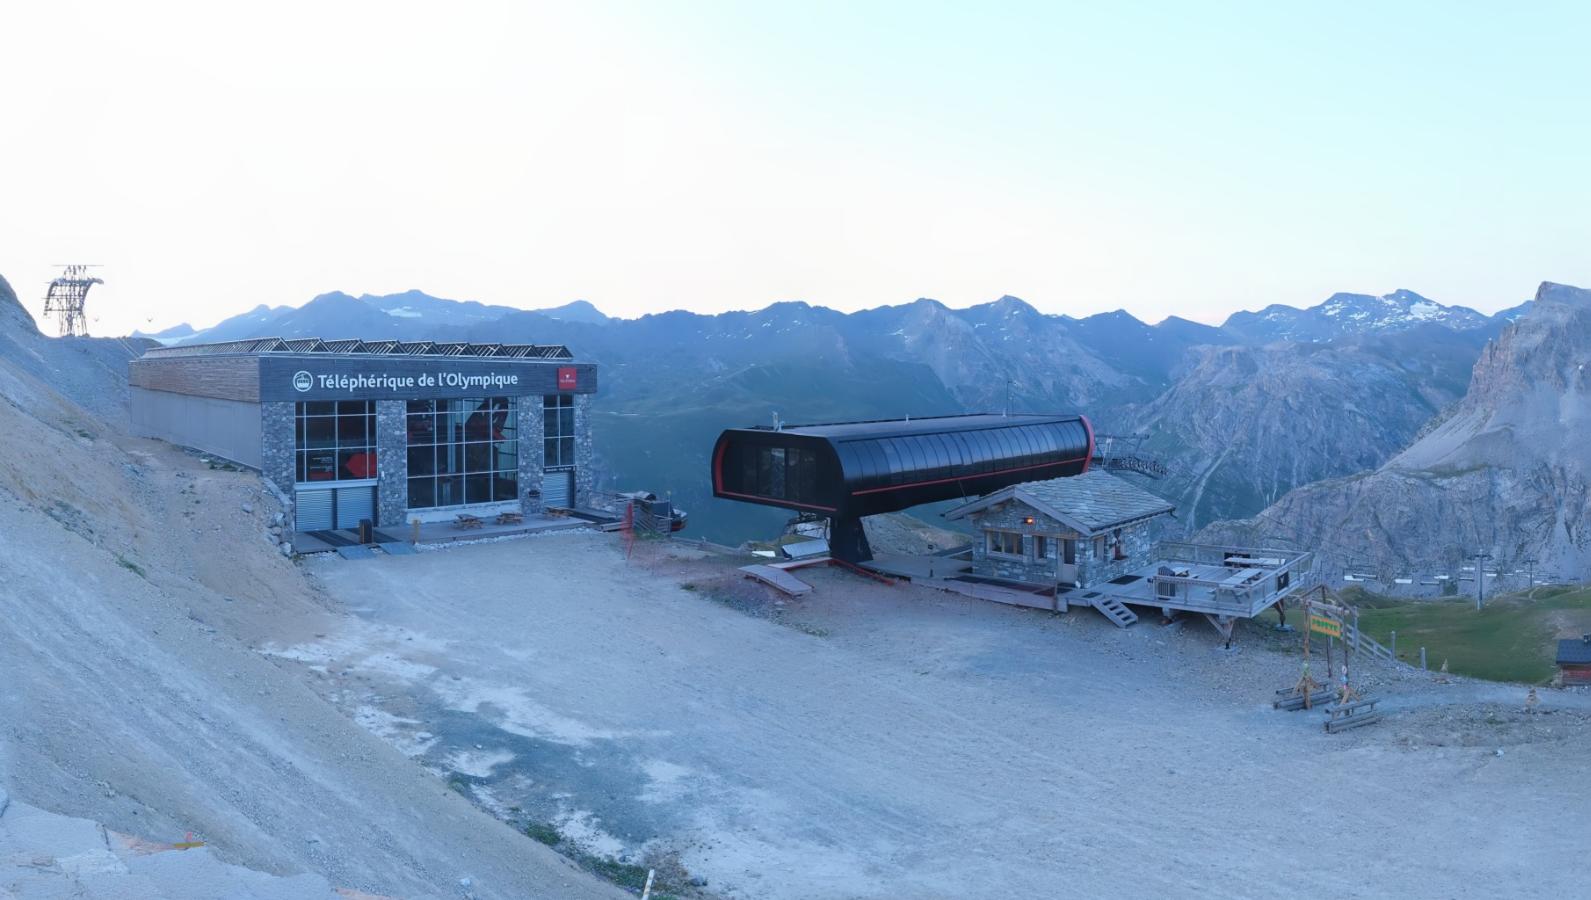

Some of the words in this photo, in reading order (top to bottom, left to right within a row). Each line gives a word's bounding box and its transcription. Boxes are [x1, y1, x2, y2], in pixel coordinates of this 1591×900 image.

[318, 373, 414, 392] Téléphérique
[418, 373, 435, 387] de
[438, 372, 518, 389] l'Olympique
